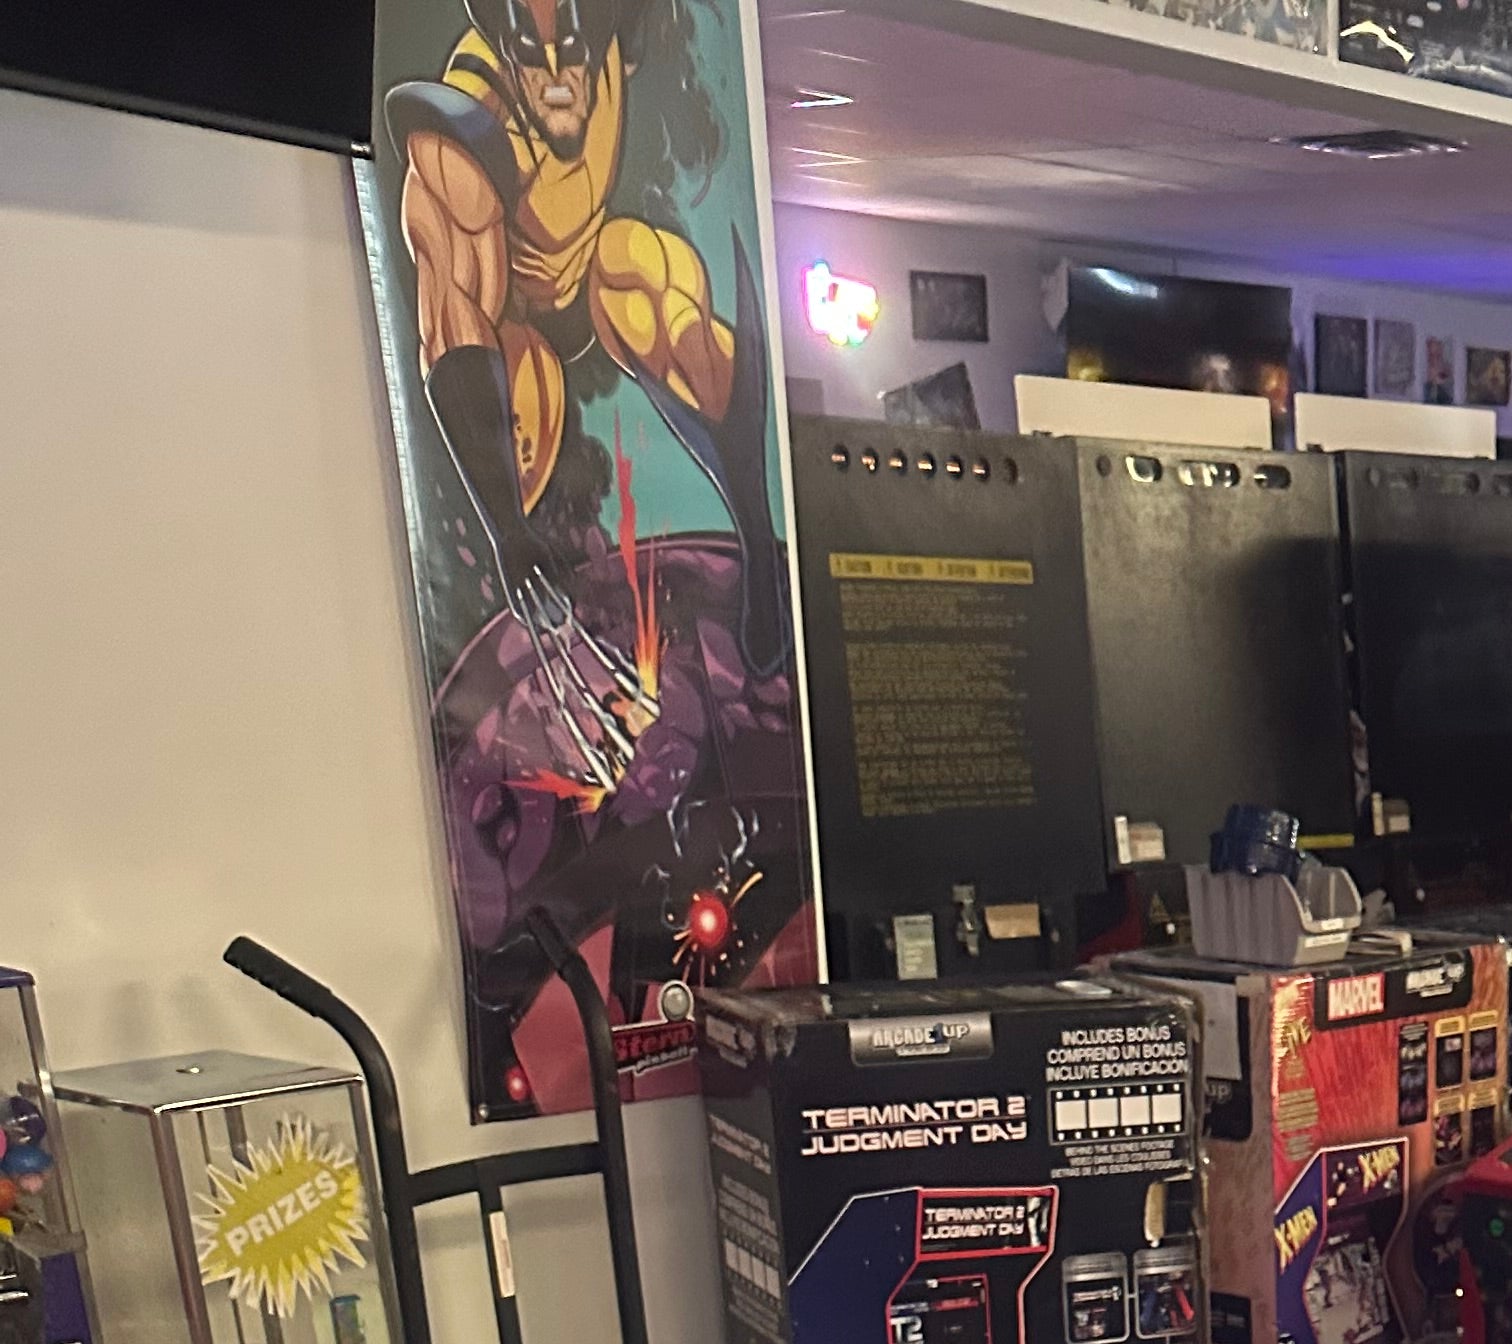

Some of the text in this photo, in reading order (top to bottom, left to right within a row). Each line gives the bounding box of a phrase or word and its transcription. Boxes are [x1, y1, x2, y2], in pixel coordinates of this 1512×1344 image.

[1328, 974, 1385, 1020] MARVEL
[1061, 1026, 1171, 1046] INCLUDES BONUS
[1047, 1042, 1186, 1064] COMPREND UN BONUS
[1046, 1065, 1100, 1082] INCLUYE
[802, 1095, 1026, 1130] TERMINATOR 2
[801, 1126, 963, 1156] JUDGMENT
[971, 1121, 1028, 1144] DAY
[225, 1169, 340, 1256] PRIZES
[924, 1206, 1025, 1222] TERMINATOR 2
[922, 1223, 997, 1240] JUDGMENT
